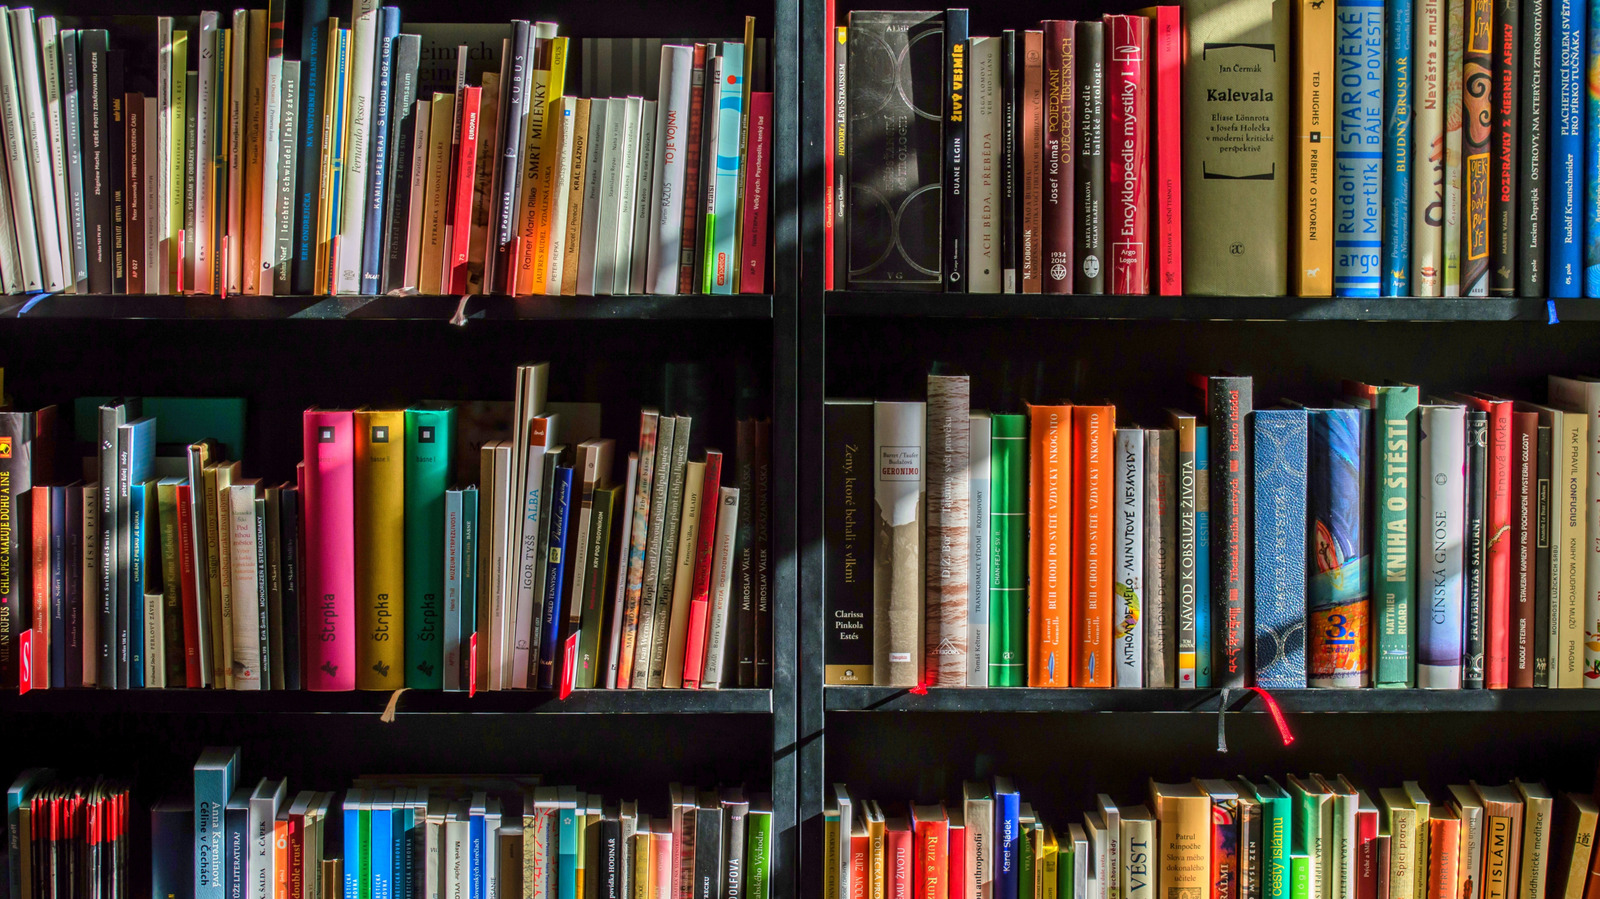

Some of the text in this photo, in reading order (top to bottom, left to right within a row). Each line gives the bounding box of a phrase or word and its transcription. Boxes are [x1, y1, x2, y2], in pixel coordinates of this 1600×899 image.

[380, 37, 390, 57] teba
[1219, 64, 1261, 73] Jan Čermák
[1503, 24, 1513, 65] AFRIKY
[379, 61, 388, 78] bez
[512, 56, 523, 104] KUBUS
[951, 44, 964, 122] ŽIVÝ VESMÍR
[1339, 12, 1362, 144] STAROVĚKÉ
[1364, 12, 1381, 144] BÁJE A POVĚSTI
[1500, 70, 1512, 115] ČIERNEJ
[1559, 32, 1570, 135] PLACHETNICÍ KOLEM
[1570, 30, 1579, 135] PRO PÍRKO TUČŇÁKA
[378, 89, 386, 117] tebou
[1060, 38, 1073, 163] O VĚCECH TIBETSKÝCH
[1093, 63, 1102, 155] baltské mytologie
[1207, 89, 1273, 101] Kalevala
[1311, 71, 1320, 125] TED HUGHES
[1395, 57, 1407, 172] BLUDNÝ BRUSLAŘ
[351, 96, 365, 173] Fernando Pessoa
[528, 82, 546, 179] SMRŤ MILENKY
[665, 110, 677, 165] TO JE VOJNA!
[1082, 85, 1092, 155] Encyklopedie
[1531, 70, 1541, 180] OSTROVY, NA KTERÝCH
[376, 136, 384, 175] PETERAJ
[981, 132, 991, 186] PŘEBĚDA
[1049, 140, 1058, 204] Josef Kolmaš
[1121, 80, 1136, 235] Encyklopedie mystiky
[1500, 132, 1511, 202] ROZPRÁVKY
[281, 145, 291, 232] leichter Schwindel
[1339, 163, 1355, 233] Rudolf
[1363, 163, 1377, 233] Mertlík
[523, 187, 537, 270] Rainer Maria Rilke
[1530, 188, 1539, 248] Lucien Deprijck
[1564, 216, 1572, 243] Rudolf
[983, 232, 991, 258] ACH
[1340, 255, 1379, 274] argo
[942, 416, 953, 452] pravěku
[1049, 414, 1058, 463] INKOGNITO
[1230, 422, 1239, 452] Bardo
[942, 454, 951, 472] svět
[1048, 467, 1058, 509] VŽDYCKY
[1385, 419, 1407, 582] KNIHA O ŠTĚSTÍ
[1569, 478, 1577, 527] KONFUCIUS
[524, 489, 538, 589] IGOR TYŠŠ ALBA
[1049, 543, 1057, 555] PO
[1180, 461, 1193, 631] NÁVOD K OBSLUZE ŽIVOTA
[1229, 478, 1240, 582] Tibetská kniha mrtvých
[1, 556, 10, 594] CHLAPEC
[1048, 559, 1057, 588] CHODÍ
[1432, 511, 1447, 624] ČÍNSKÁ GNOSE
[1470, 519, 1480, 641] FRATERNITAS SATURNI
[318, 594, 338, 641] Štrpka
[372, 593, 391, 641] Štrpka
[418, 593, 438, 641] Štrpka
[835, 610, 863, 618] Clarissa
[1048, 591, 1057, 609] BŮH
[1386, 593, 1395, 634] MATTHIEU
[1398, 603, 1406, 634] RICARD
[835, 621, 863, 629] Pinkola
[840, 632, 858, 640] Estés
[212, 802, 221, 887] Anna Kareninová
[754, 831, 764, 865] Východu
[1003, 820, 1011, 848] Sládek
[1271, 817, 1284, 858] islámu
[1398, 818, 1407, 848] prorok
[1492, 822, 1505, 882] ISLÁMU
[1534, 813, 1543, 849] meditace
[896, 848, 904, 879] ŽIVOTU
[1110, 859, 1118, 890] duchovní
[1126, 838, 1147, 892] VÉST
